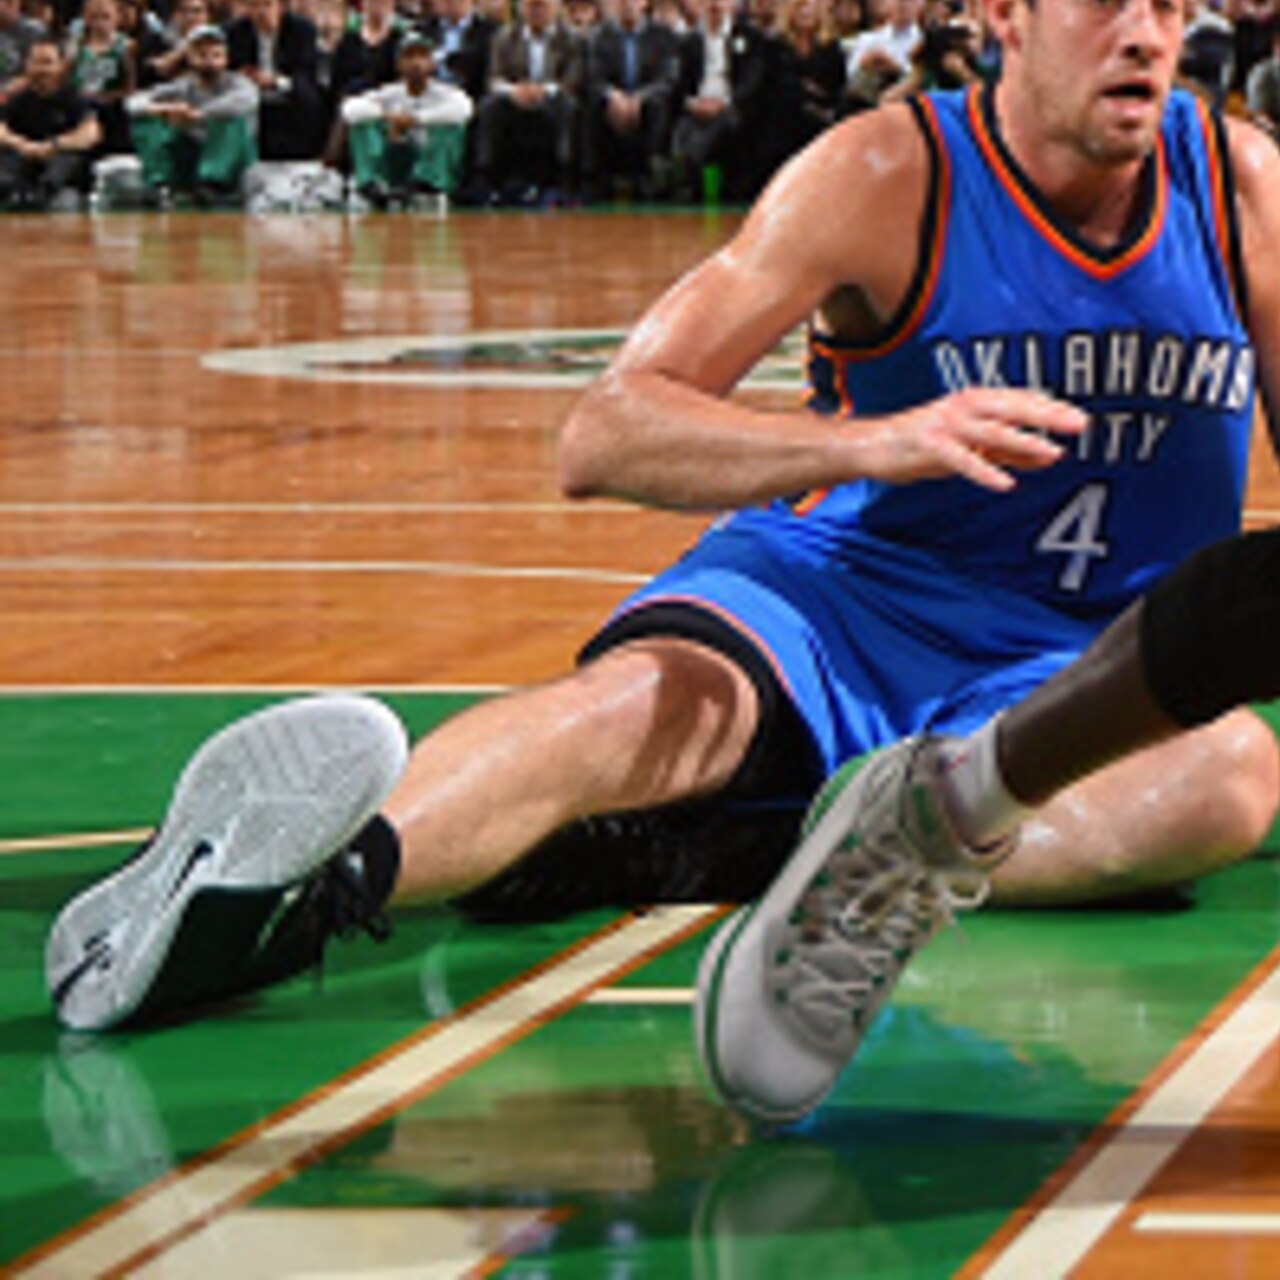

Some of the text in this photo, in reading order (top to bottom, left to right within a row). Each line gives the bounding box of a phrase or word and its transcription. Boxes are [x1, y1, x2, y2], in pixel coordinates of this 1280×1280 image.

[933, 331, 1257, 411] OKLAHOMA
[1070, 412, 1172, 463] ITY
[1036, 482, 1109, 591] 4
